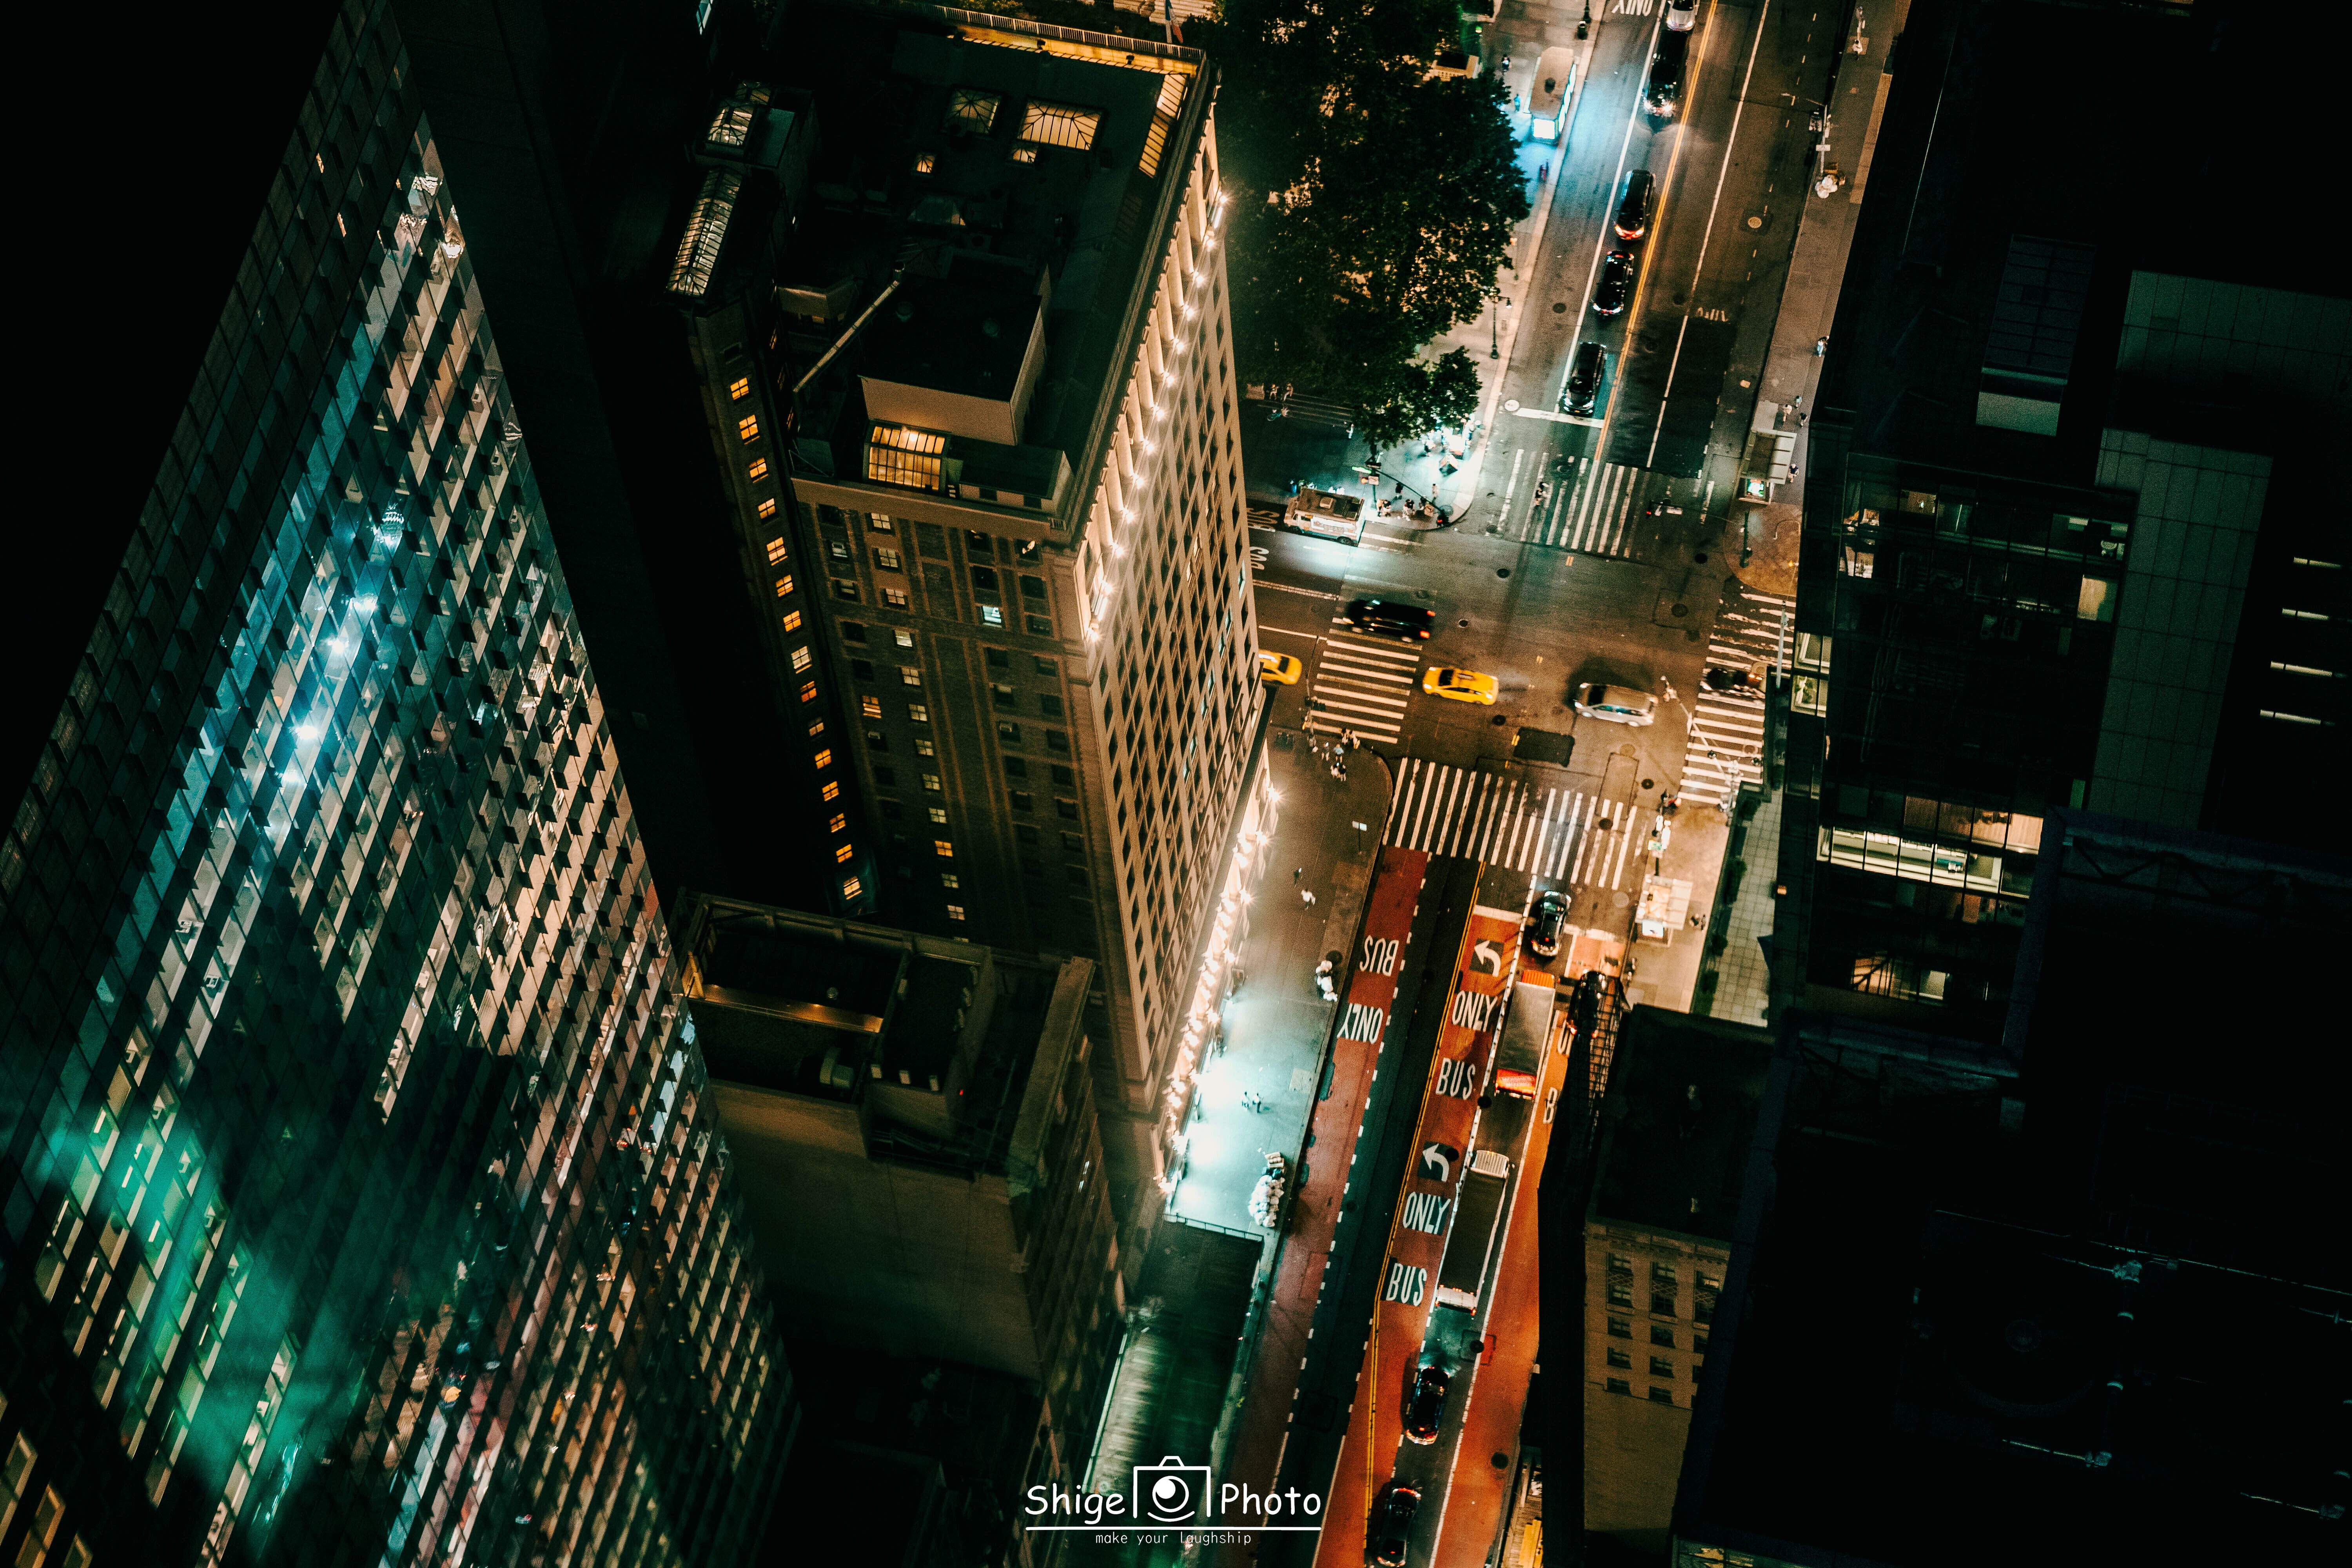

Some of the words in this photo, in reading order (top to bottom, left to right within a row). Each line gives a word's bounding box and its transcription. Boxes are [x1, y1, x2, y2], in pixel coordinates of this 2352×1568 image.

[1359, 935, 1399, 976] BUS
[1337, 1003, 1383, 1044] ONLY
[1452, 990, 1498, 1032] ONLY
[1436, 1058, 1475, 1100] BUS
[1403, 1191, 1451, 1234] ONLY
[1386, 1263, 1427, 1306] BUS
